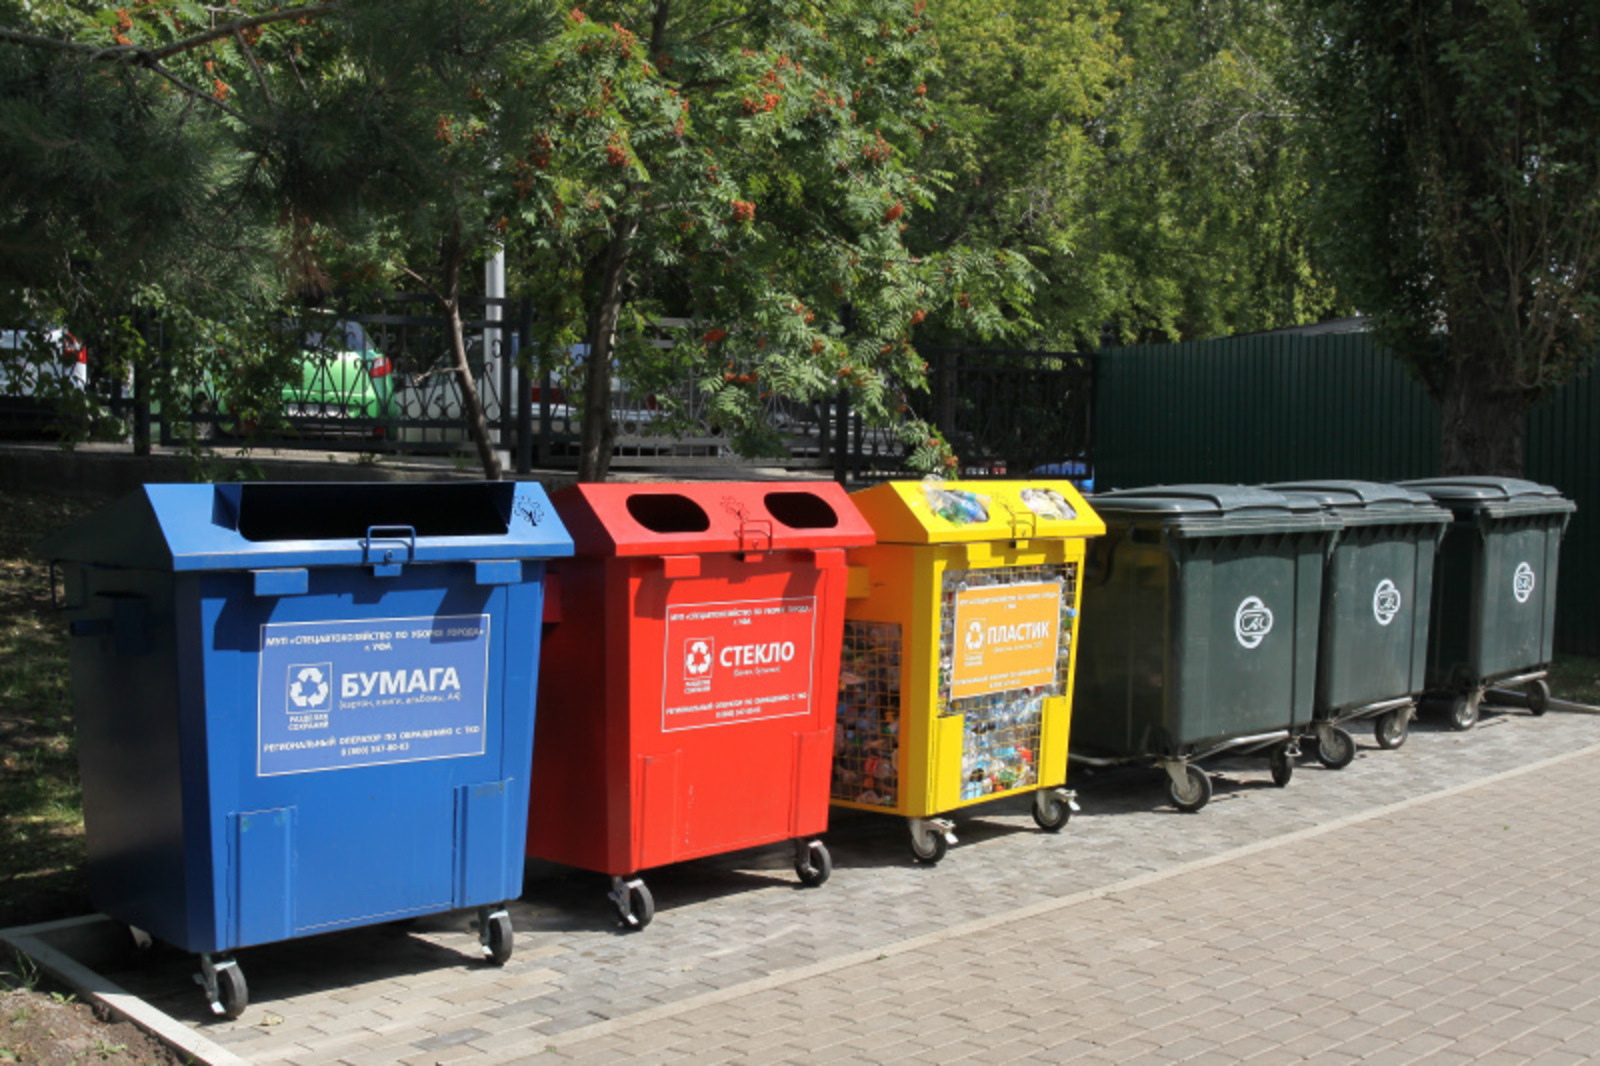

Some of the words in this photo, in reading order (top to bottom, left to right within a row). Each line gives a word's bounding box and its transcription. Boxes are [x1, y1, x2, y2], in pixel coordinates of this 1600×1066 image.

[987, 621, 1050, 645] ПЛАСТИК
[719, 641, 795, 667] СТЕКЛО
[341, 666, 461, 698] БУМАГА
